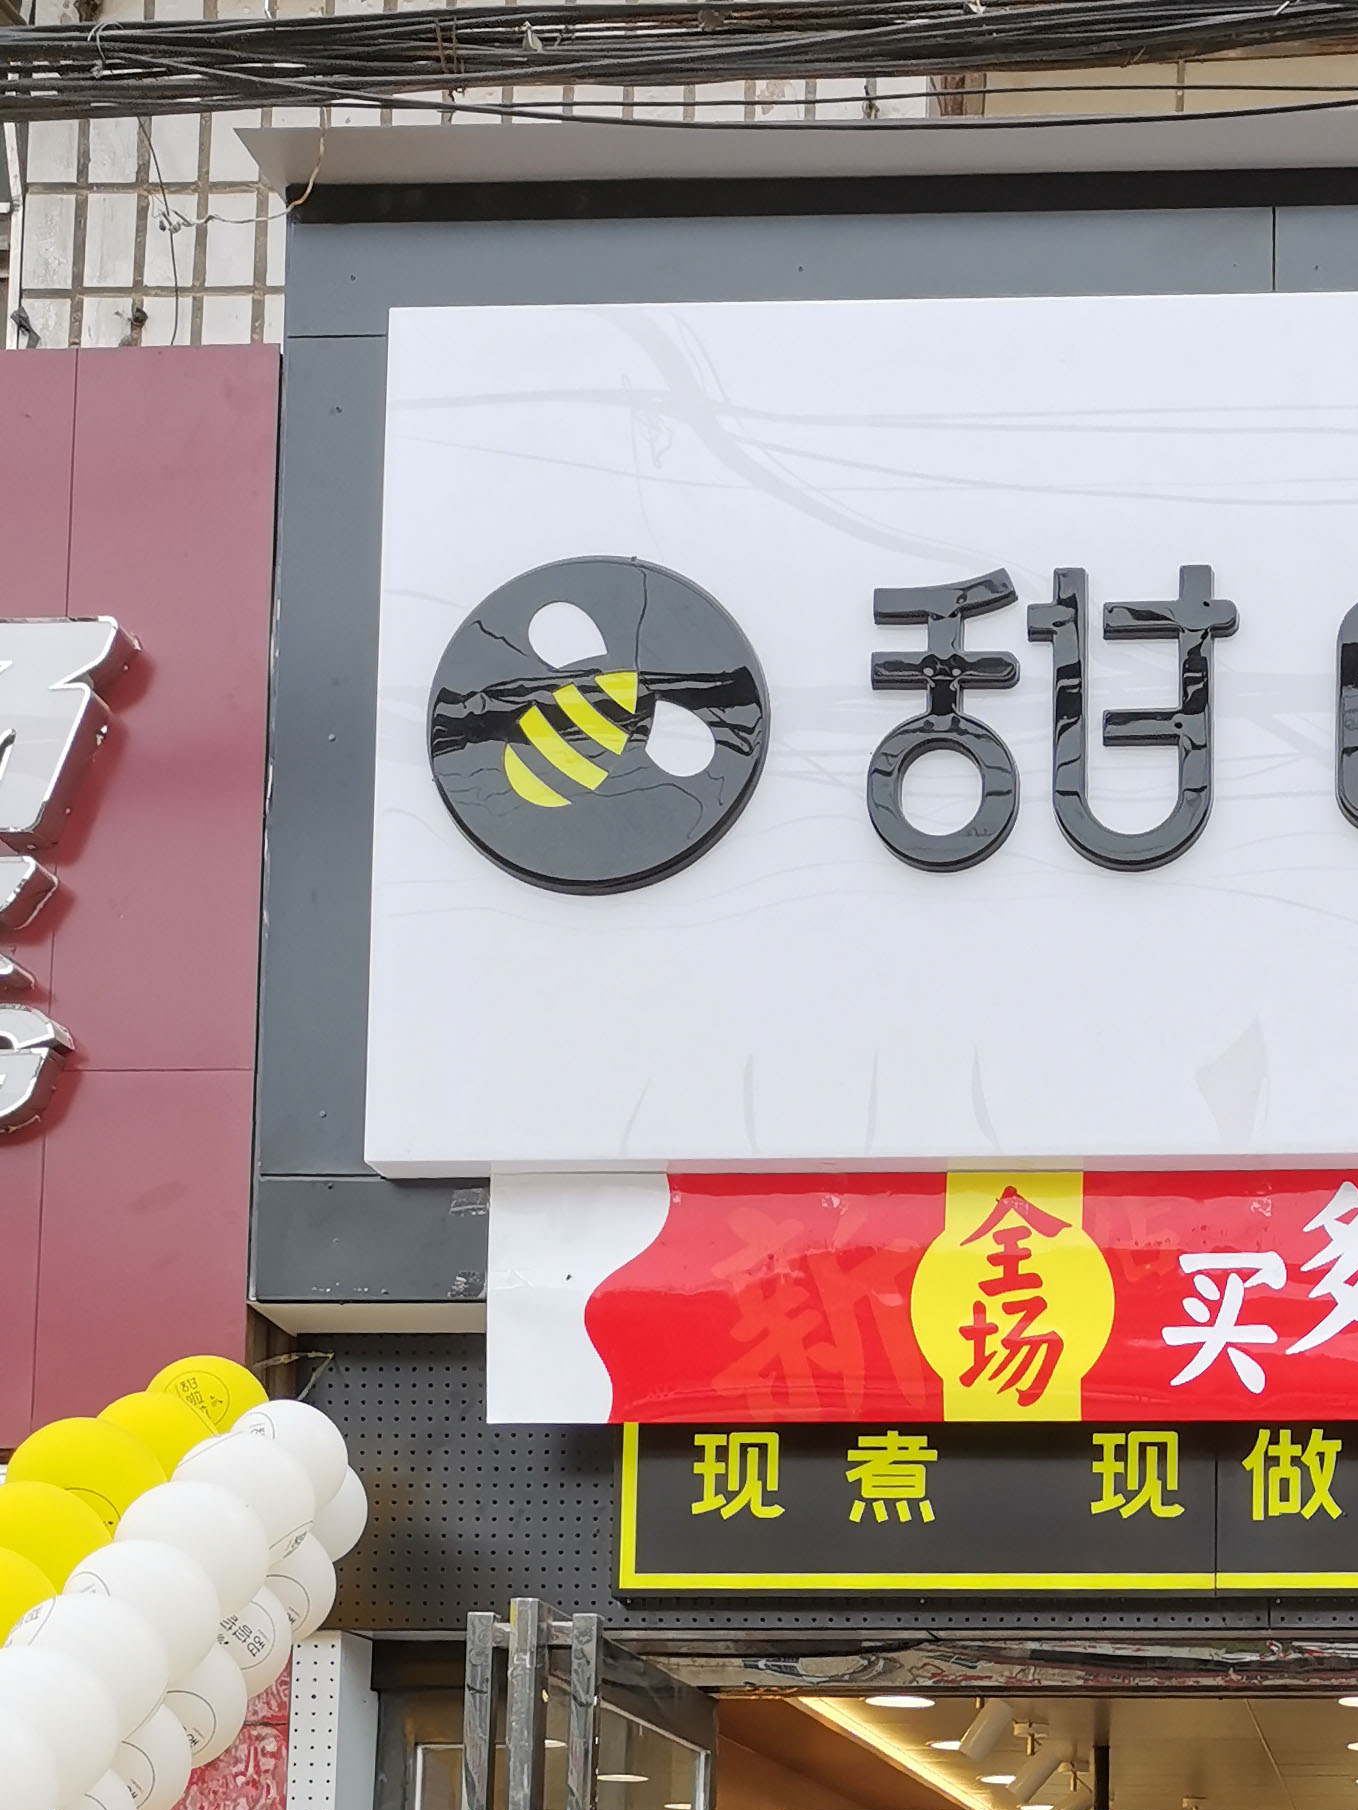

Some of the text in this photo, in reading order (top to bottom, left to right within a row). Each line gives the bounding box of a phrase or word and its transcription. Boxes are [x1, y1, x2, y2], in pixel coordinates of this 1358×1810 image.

[957, 1185, 1073, 1408] 全场
[690, 1430, 939, 1523] 现煮
[1089, 1428, 1343, 1521] 现做
